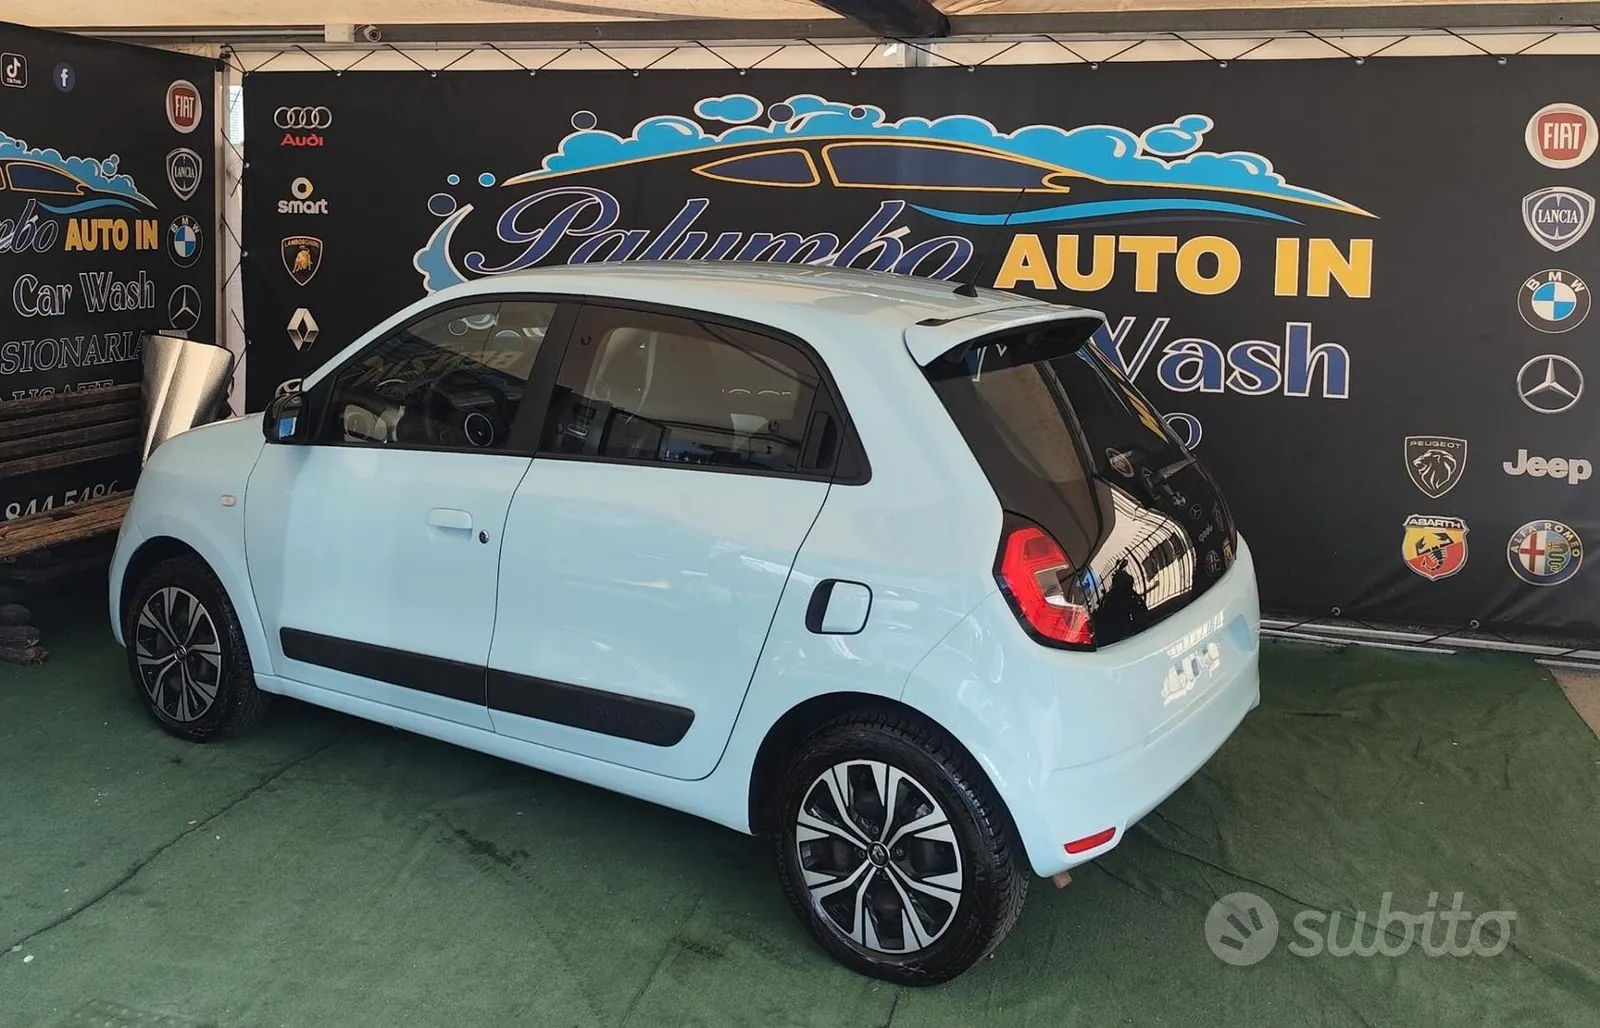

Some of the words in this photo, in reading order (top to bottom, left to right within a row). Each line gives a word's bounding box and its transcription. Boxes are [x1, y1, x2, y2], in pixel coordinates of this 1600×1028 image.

[175, 94, 195, 119] FIAT
[281, 133, 324, 147] Audi
[1543, 122, 1582, 150] FIAT
[174, 166, 195, 179] LANCIA
[277, 200, 328, 215] smart
[1538, 209, 1579, 224] LANCIA
[65, 219, 129, 250] AUTO
[136, 218, 158, 250] IN
[462, 186, 974, 282] Palumbo
[993, 233, 1242, 295] AUTO
[1274, 237, 1374, 298] IN
[1525, 271, 1585, 292] BMW
[13, 273, 73, 317] Car
[79, 270, 155, 314] Wash
[1410, 441, 1461, 449] PEUGEOT
[1503, 449, 1592, 484] Jeep
[1409, 518, 1460, 528] ABARTH
[1511, 524, 1537, 553] ALFA
[1544, 522, 1580, 557] ROMEO
